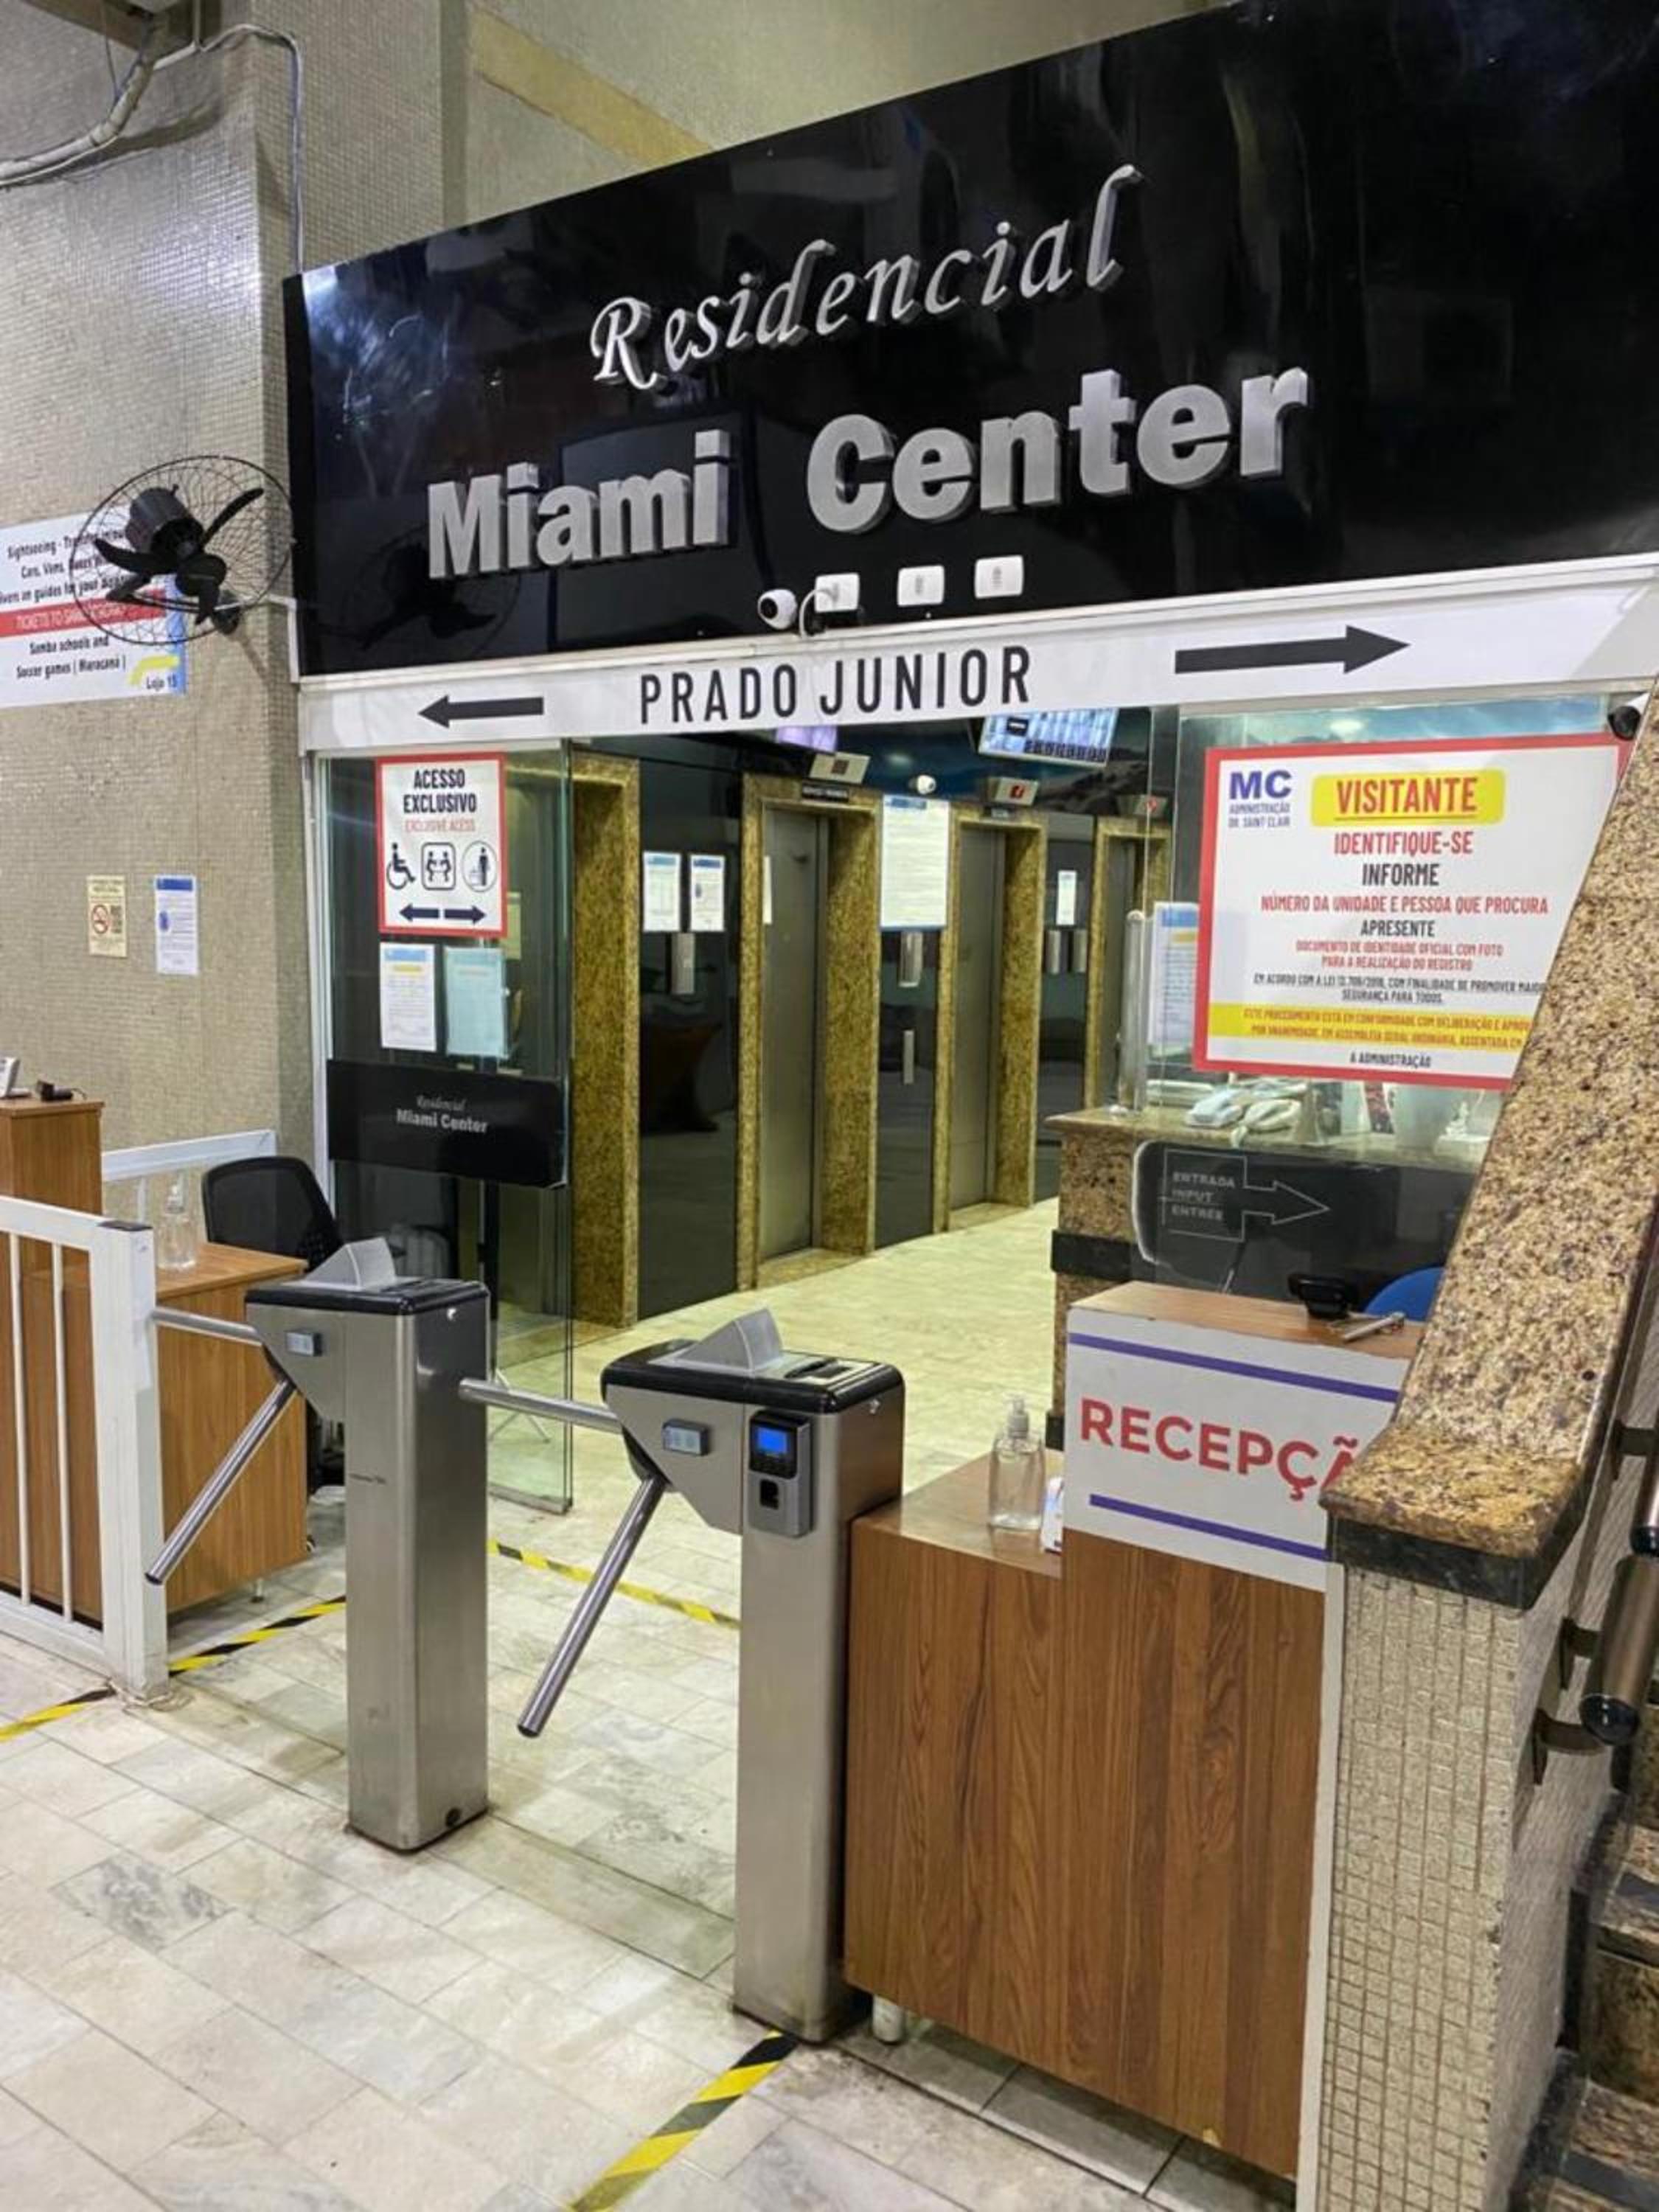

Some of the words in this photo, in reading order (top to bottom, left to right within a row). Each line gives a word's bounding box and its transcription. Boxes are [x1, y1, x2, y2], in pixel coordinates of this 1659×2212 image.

[591, 164, 1143, 390] Residencial
[428, 429, 730, 579] Miami
[807, 367, 1309, 534] Center
[29, 641, 57, 655] Samba
[60, 636, 90, 652] schools
[93, 633, 109, 647] and
[16, 665, 42, 680] Soccer
[45, 662, 72, 680] games
[147, 676, 165, 691] Loja
[640, 664, 797, 725] PRADO
[820, 645, 1030, 716] JUNIOR
[414, 769, 465, 788] ACESSO
[1229, 770, 1293, 800] MC
[1336, 776, 1478, 815] VISITANTE
[403, 793, 477, 813] EXCLUSIVO
[1334, 831, 1473, 856] IDENTIFIQUE-SE
[1362, 863, 1439, 886] INFORME
[1261, 891, 1310, 911] NÚMERO
[1313, 896, 1329, 911] DA
[1333, 896, 1388, 912] UNIDADE
[1390, 896, 1399, 912] E
[1402, 896, 1451, 913] PESSOA
[1455, 896, 1481, 914] QUE
[1485, 896, 1548, 914] PROCURA
[1360, 920, 1436, 937] APRESENTE
[1296, 940, 1348, 952] DOCUMENTO
[1350, 941, 1361, 953] DE
[1363, 941, 1416, 954] IDENTIDADE
[1419, 943, 1453, 955] OFICIAL
[1456, 944, 1475, 956] COM
[1478, 944, 1504, 956] FOTO
[1322, 956, 1344, 968] PARA
[1348, 957, 1354, 968] A
[1413, 959, 1426, 970] DO
[1427, 959, 1473, 971] REGISTRO
[1298, 974, 1314, 985] COM
[1388, 978, 1405, 989] COM
[1408, 978, 1455, 990] FINALIDADE
[1458, 980, 1467, 990] DE
[1470, 980, 1515, 992] PROMOVER
[1342, 989, 1389, 1001] SEGURANÇA
[1391, 990, 1413, 1001] PARA
[1351, 1051, 1356, 1062] A
[1359, 1052, 1431, 1067] ADMINISTRAÇÃO
[396, 1108, 437, 1127] Miami
[440, 1113, 488, 1133] Center
[1172, 1171, 1236, 1188] ENTRADA
[1172, 1189, 1214, 1203] INPUT
[1080, 1397, 1358, 1502] RECEPÇÃ
